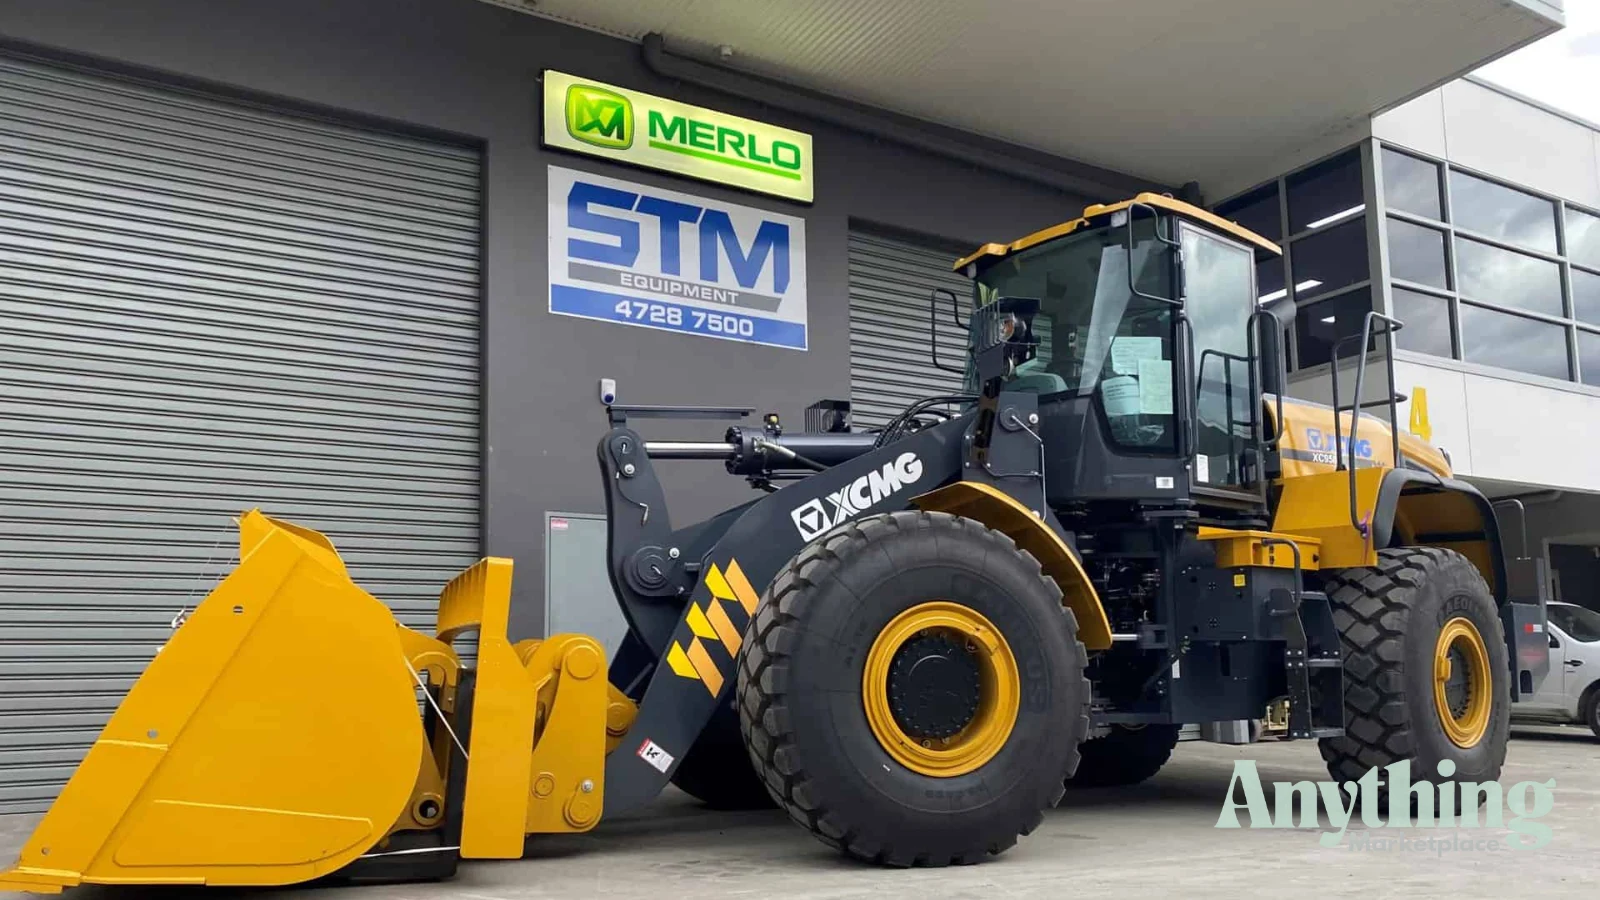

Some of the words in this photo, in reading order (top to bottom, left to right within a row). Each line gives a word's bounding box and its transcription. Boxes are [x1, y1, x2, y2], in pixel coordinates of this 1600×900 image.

[648, 109, 801, 171] MERLO
[567, 181, 791, 294] STM
[620, 272, 739, 304] EQUIPMENT
[615, 300, 683, 326] 4728
[692, 310, 754, 337] 7500
[1410, 386, 1432, 442] 4
[825, 452, 923, 527] XCMG
